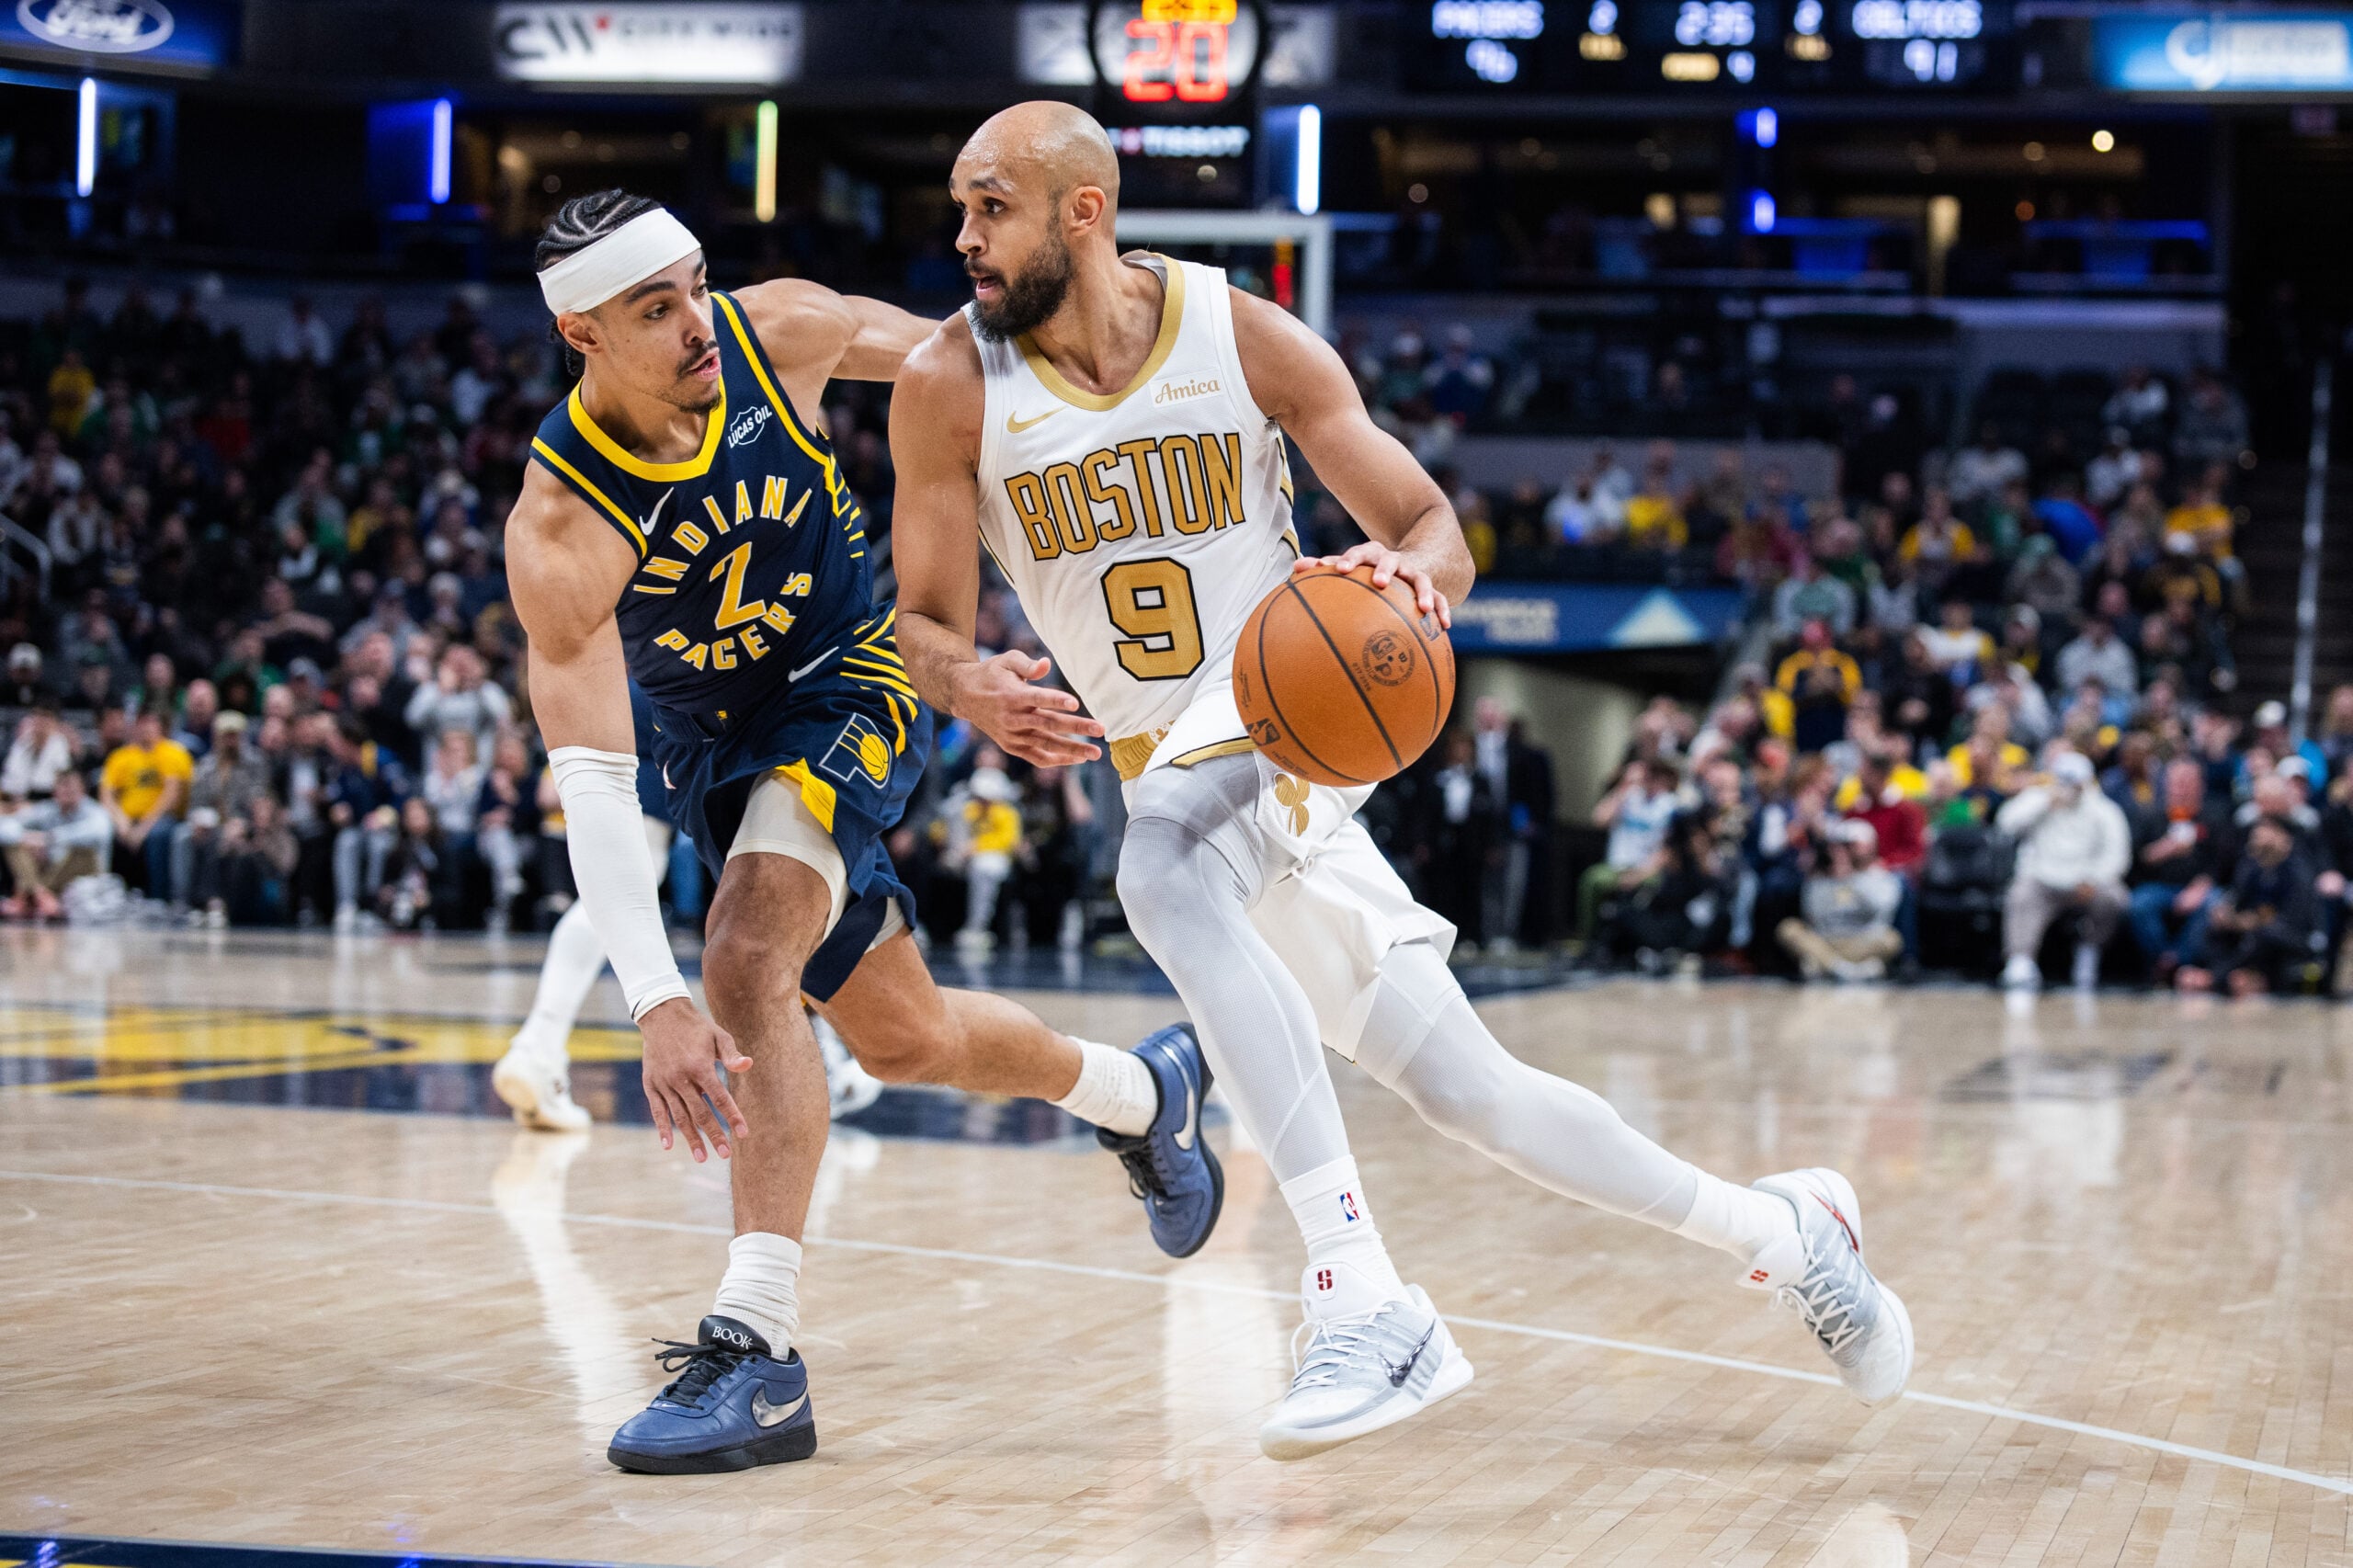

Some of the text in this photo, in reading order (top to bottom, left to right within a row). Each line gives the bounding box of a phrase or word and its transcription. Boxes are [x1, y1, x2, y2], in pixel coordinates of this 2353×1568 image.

[1123, 19, 1228, 101] 20
[728, 405, 772, 449] LUCAS OIL
[1155, 379, 1221, 403] Amica
[633, 475, 813, 595] INDIANA
[1005, 432, 1245, 561] BOSTON
[654, 572, 813, 671] PACERS
[709, 541, 767, 631] 2
[1101, 557, 1205, 681] 9
[711, 1325, 752, 1350] BOOK
